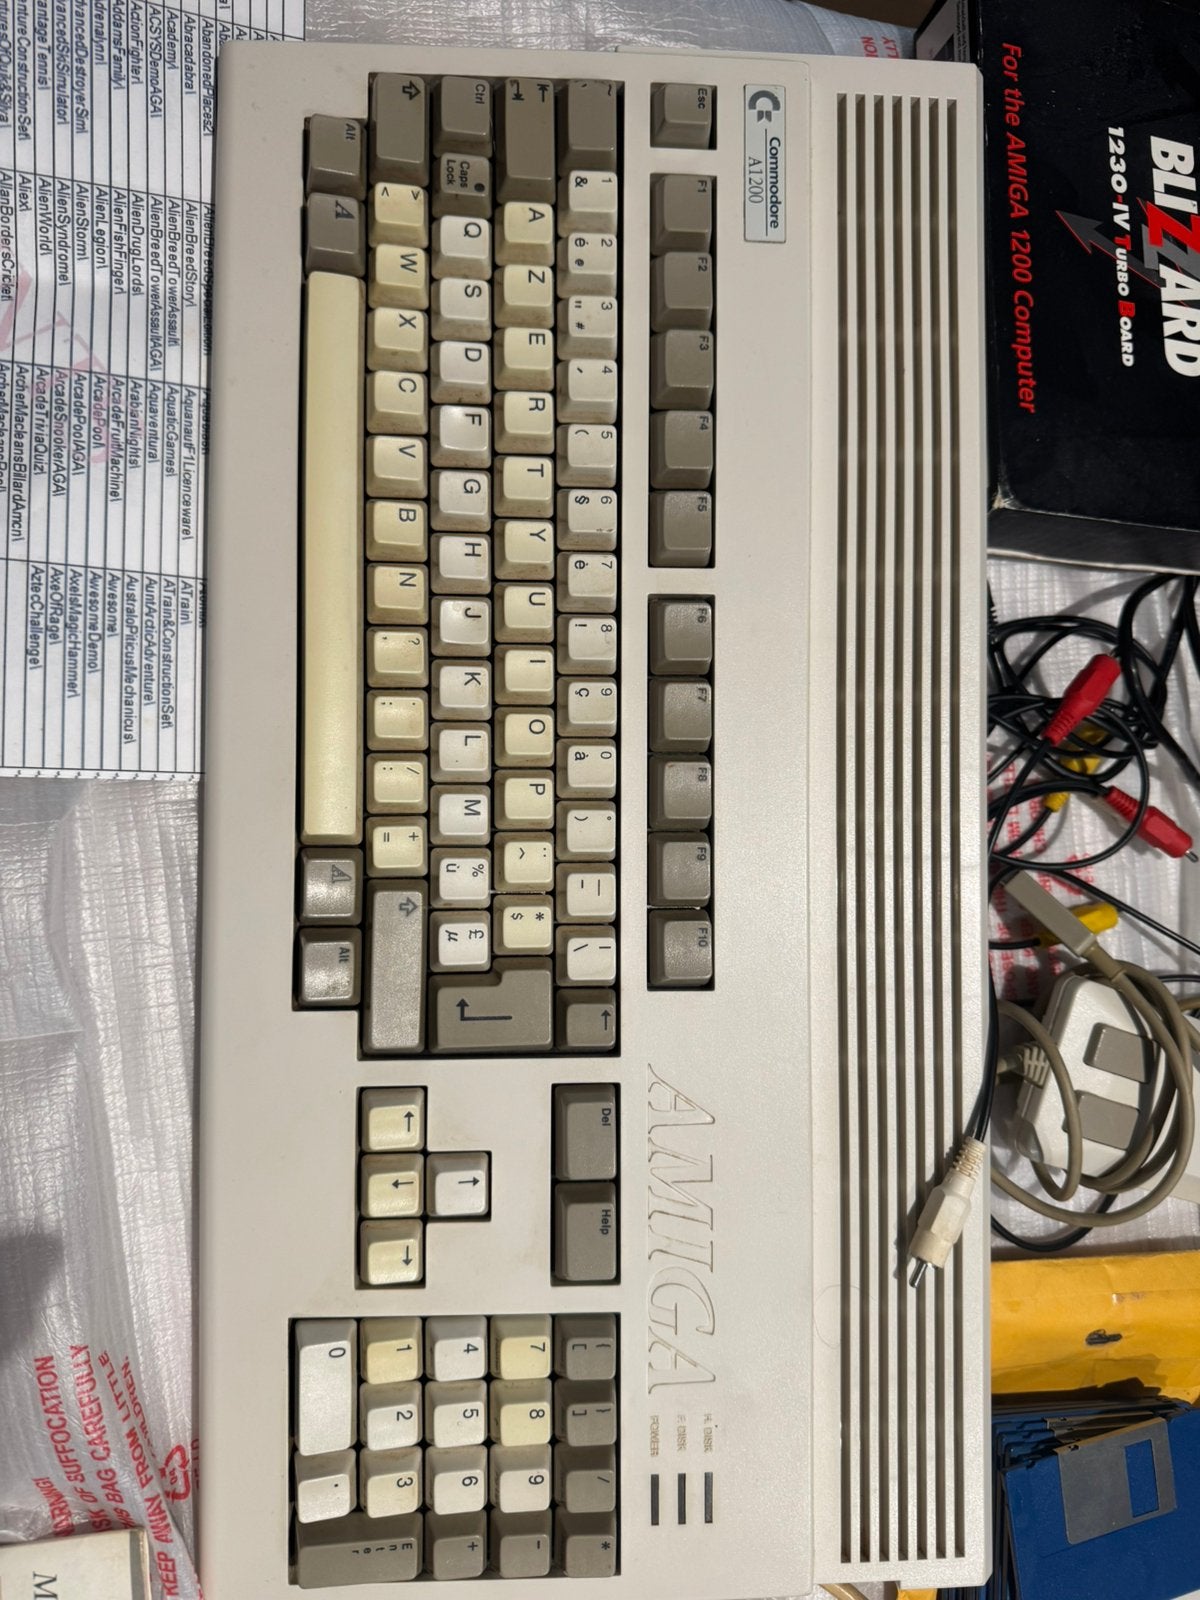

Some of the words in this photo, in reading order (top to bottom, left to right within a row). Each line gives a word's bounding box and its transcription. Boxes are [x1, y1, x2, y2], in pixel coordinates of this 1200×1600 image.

[92, 0, 108, 66] drenalynn\
[34, 0, 51, 90] antageTennis\
[1001, 42, 1022, 82] For
[474, 84, 486, 104] Ctrl
[698, 88, 708, 109] Esc
[1004, 88, 1026, 125] the
[345, 124, 356, 140] Alt
[446, 160, 456, 186] Lock
[457, 161, 470, 188] Caps
[748, 156, 764, 204] A1200
[1005, 132, 1028, 218] AMIGA
[1108, 127, 1131, 232] 1230-IV
[574, 176, 588, 188] &
[698, 180, 707, 194] F1
[768, 137, 782, 228] Commodore
[528, 208, 545, 222] A
[464, 222, 482, 238] Q
[574, 238, 588, 248] é
[602, 238, 612, 248] 2
[400, 253, 417, 273] W
[1010, 230, 1033, 283] 1200
[1142, 136, 1200, 377] BLIZZARD
[698, 257, 707, 272] F2
[528, 270, 545, 284] Z
[464, 284, 482, 298] S
[602, 302, 612, 311] 3
[399, 314, 416, 329] X
[528, 332, 546, 346] E
[699, 335, 708, 350] F3
[464, 348, 482, 362] D
[1012, 290, 1037, 413] Computer
[602, 366, 612, 374] 4
[399, 378, 416, 392] C
[528, 398, 546, 412] R
[464, 413, 482, 426] F
[698, 416, 708, 430] F4
[602, 430, 612, 440] 5
[399, 444, 416, 458] V
[526, 464, 544, 478] T
[464, 478, 481, 494] G
[601, 496, 612, 504] 6
[698, 496, 708, 512] F5
[399, 508, 416, 522] B
[530, 529, 546, 542] Y
[464, 542, 481, 557] H
[602, 560, 612, 570] 7
[400, 572, 416, 587] N
[528, 592, 546, 606] U
[464, 608, 482, 618] J
[697, 607, 707, 624] F6
[601, 624, 612, 632] 8
[464, 672, 481, 686] K
[601, 688, 612, 696] 9
[697, 687, 707, 702] F7
[528, 718, 546, 735] O
[464, 736, 481, 746] L
[574, 751, 588, 762] à
[601, 751, 612, 759] 0
[698, 766, 708, 782] F8
[529, 784, 546, 796] P
[464, 800, 481, 816] M
[696, 846, 706, 862] F9
[698, 926, 708, 948] F10
[338, 946, 350, 964] Alt
[601, 1108, 612, 1126] Del
[600, 1209, 612, 1235] Help
[647, 1062, 716, 1395] AMIGA
[328, 1348, 346, 1358] 0
[396, 1344, 412, 1352] 1
[463, 1343, 478, 1354] 4
[530, 1342, 545, 1352] 7
[99, 1352, 131, 1423] LITTLE
[68, 1345, 112, 1461] CAREFULLY
[33, 1355, 85, 1482] SUFFOCATION
[396, 1410, 412, 1421] 2
[462, 1408, 478, 1419] 5
[529, 1409, 544, 1420] 8
[122, 1426, 154, 1489] FROM
[97, 1468, 125, 1503] BAG
[396, 1476, 413, 1488] 3
[462, 1476, 478, 1487] 6
[529, 1474, 544, 1486] 9
[72, 1487, 100, 1504] OF
[144, 1496, 174, 1545] AWAY
[352, 1543, 412, 1554] Enter
[156, 1551, 180, 1597] KEEP
